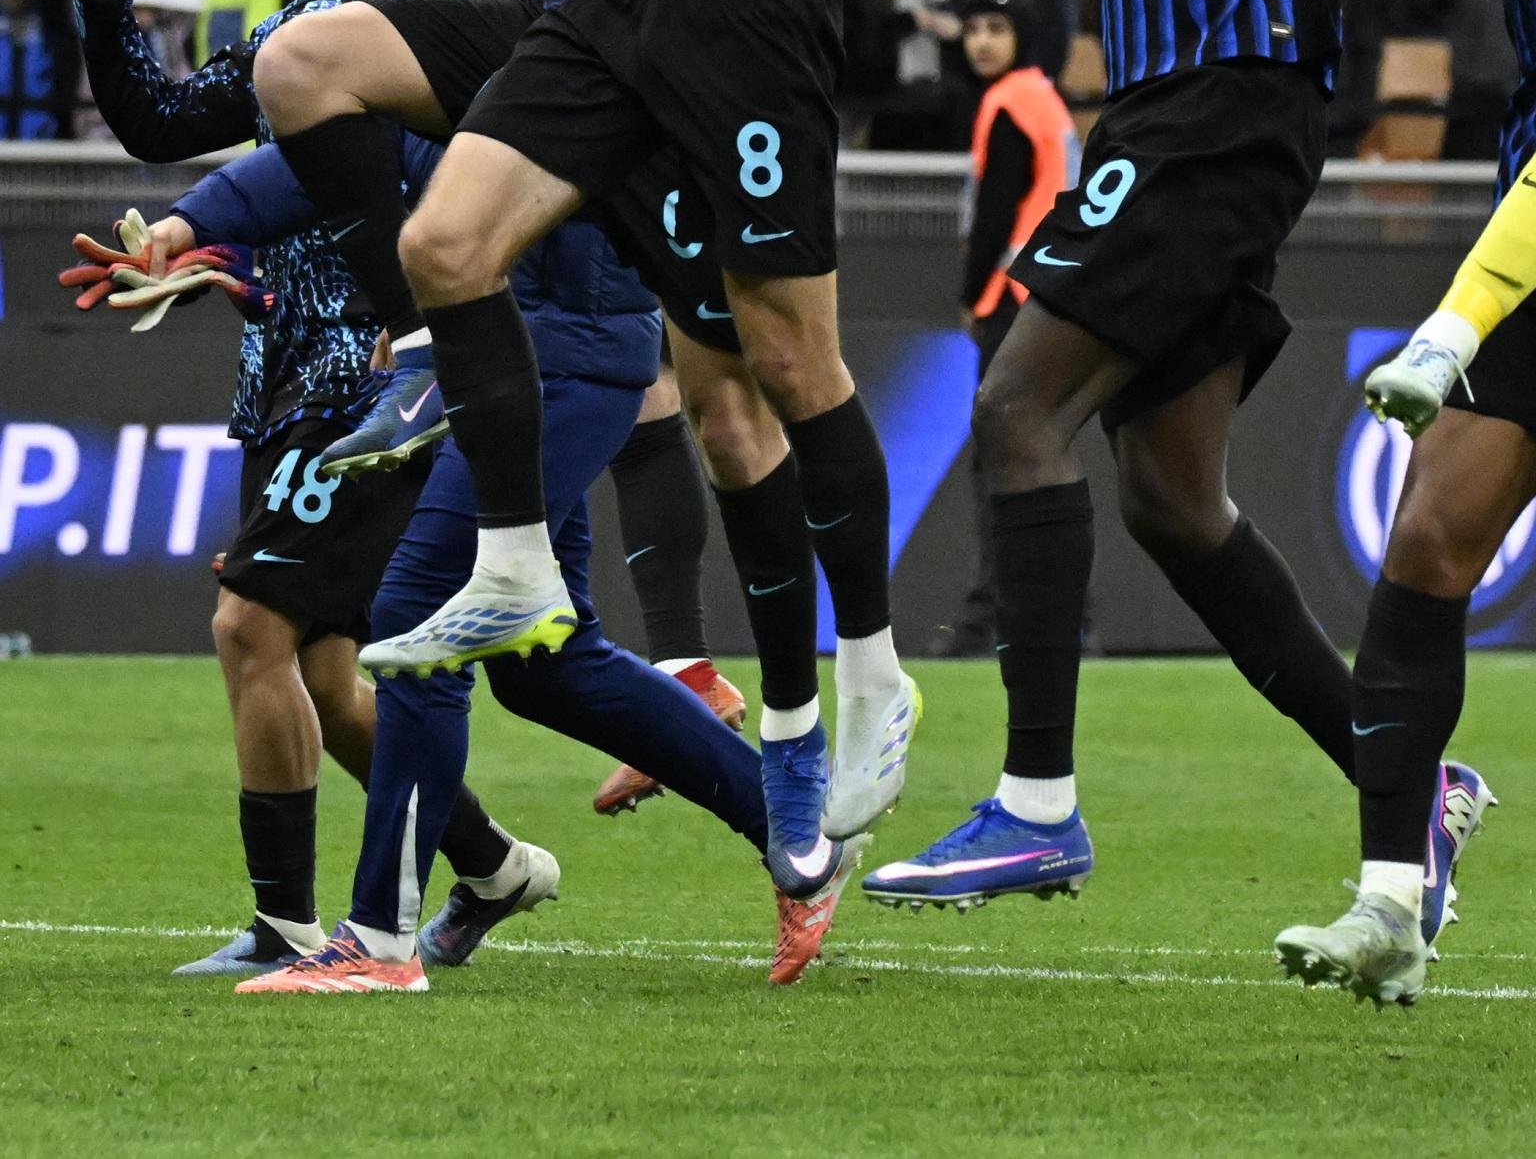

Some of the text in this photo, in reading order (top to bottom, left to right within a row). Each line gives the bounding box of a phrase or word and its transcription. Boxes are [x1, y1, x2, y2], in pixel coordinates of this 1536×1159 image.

[736, 120, 783, 198] 8
[1080, 158, 1136, 227] 9
[263, 448, 342, 523] 48
